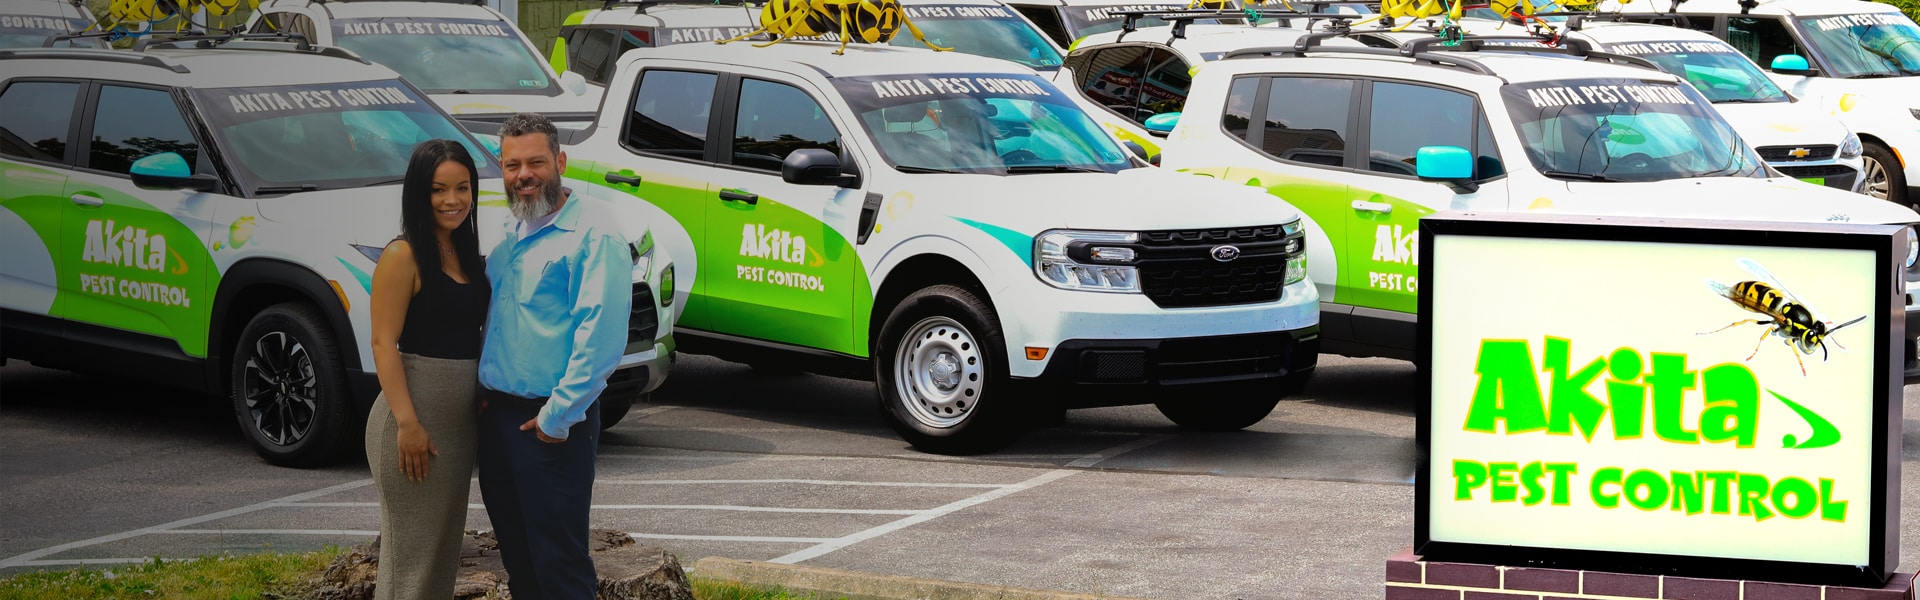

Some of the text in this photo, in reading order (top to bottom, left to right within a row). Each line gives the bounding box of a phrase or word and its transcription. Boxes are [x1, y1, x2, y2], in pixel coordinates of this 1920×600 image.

[1, 15, 76, 32] CONTROL
[919, 6, 955, 18] PEST
[954, 6, 1013, 18] CONTROL
[1816, 15, 1854, 32] AKITA
[344, 22, 509, 37] AKITA PEST CONTROL
[671, 27, 723, 43] AKITA
[1612, 41, 1734, 56] AKITA PEST CONTROL
[228, 86, 417, 114] AKITA PEST CONTROL
[871, 77, 1051, 99] AKITA PEST CONTROL
[1526, 84, 1696, 108] AKITA PEST CONTROL
[82, 218, 167, 273] Akita
[739, 223, 806, 266] Akita
[1372, 223, 1419, 267] Aki
[736, 264, 825, 293] PEST CONTROL
[1369, 271, 1403, 292] PEST
[80, 273, 191, 309] PEST CONTROL
[1462, 334, 1762, 449] Akita
[1452, 458, 1849, 524] PEST CONTROL
